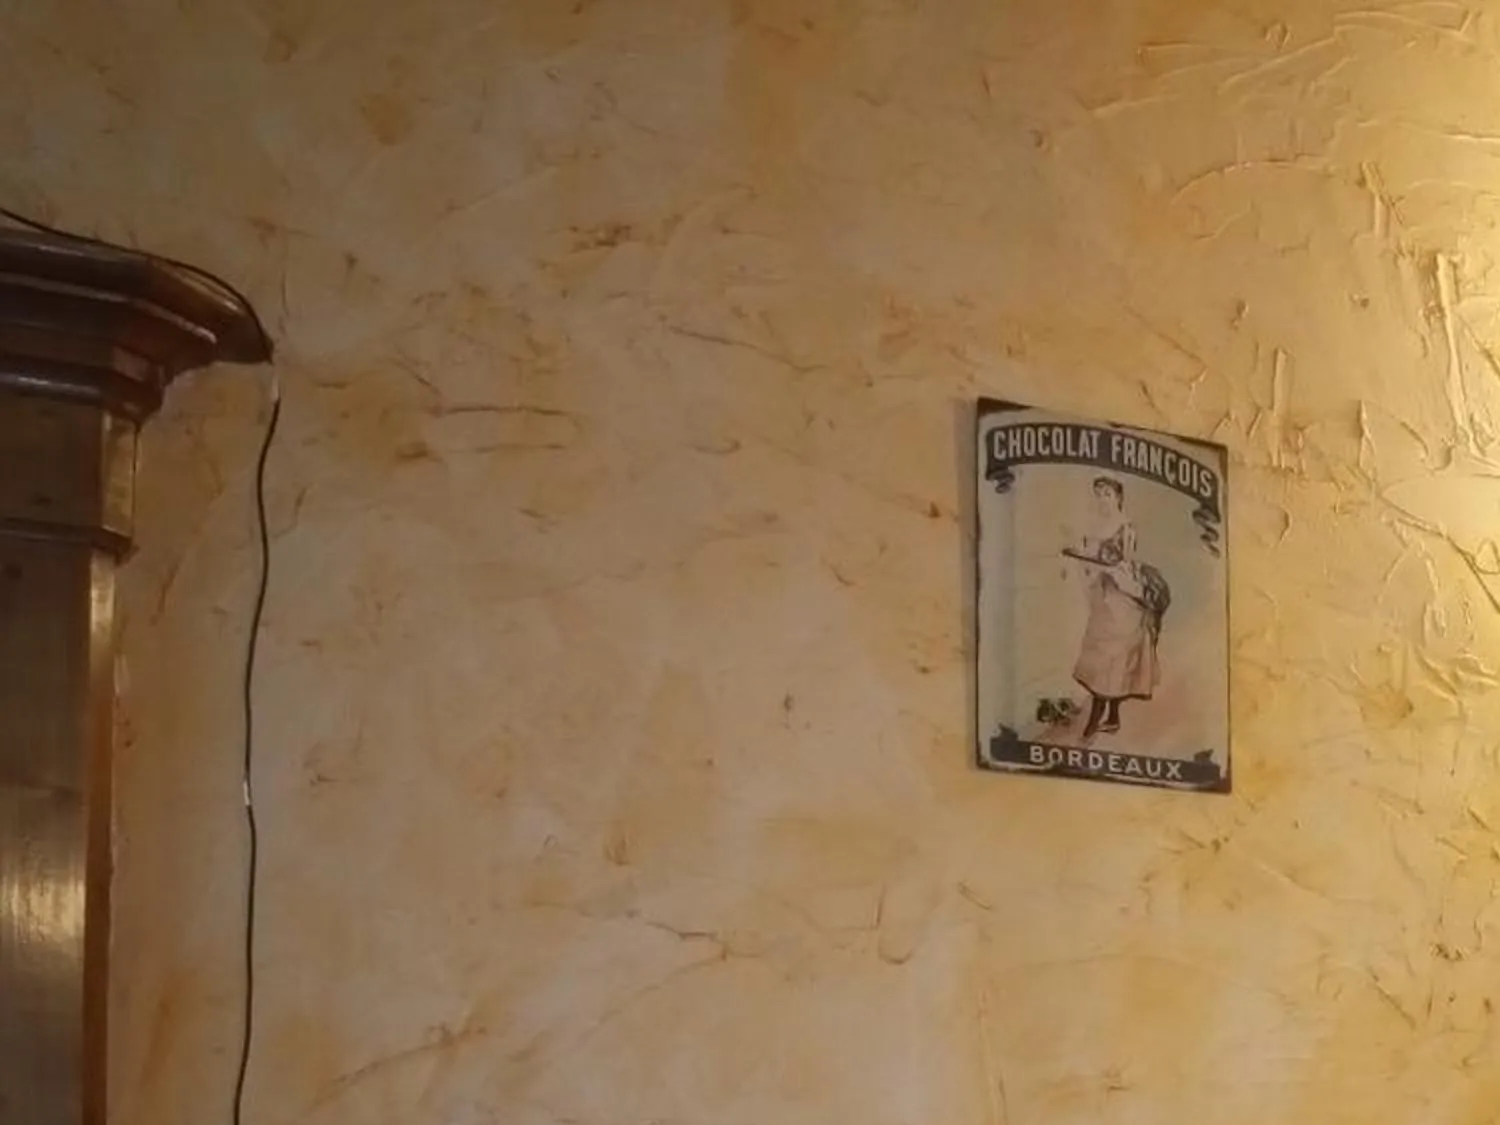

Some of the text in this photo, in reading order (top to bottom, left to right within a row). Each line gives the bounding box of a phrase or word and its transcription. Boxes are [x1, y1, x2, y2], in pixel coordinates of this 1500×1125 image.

[993, 426, 1212, 498] CHOCOLAT FRANÇOIS
[1029, 745, 1182, 779] BORDEAUX
